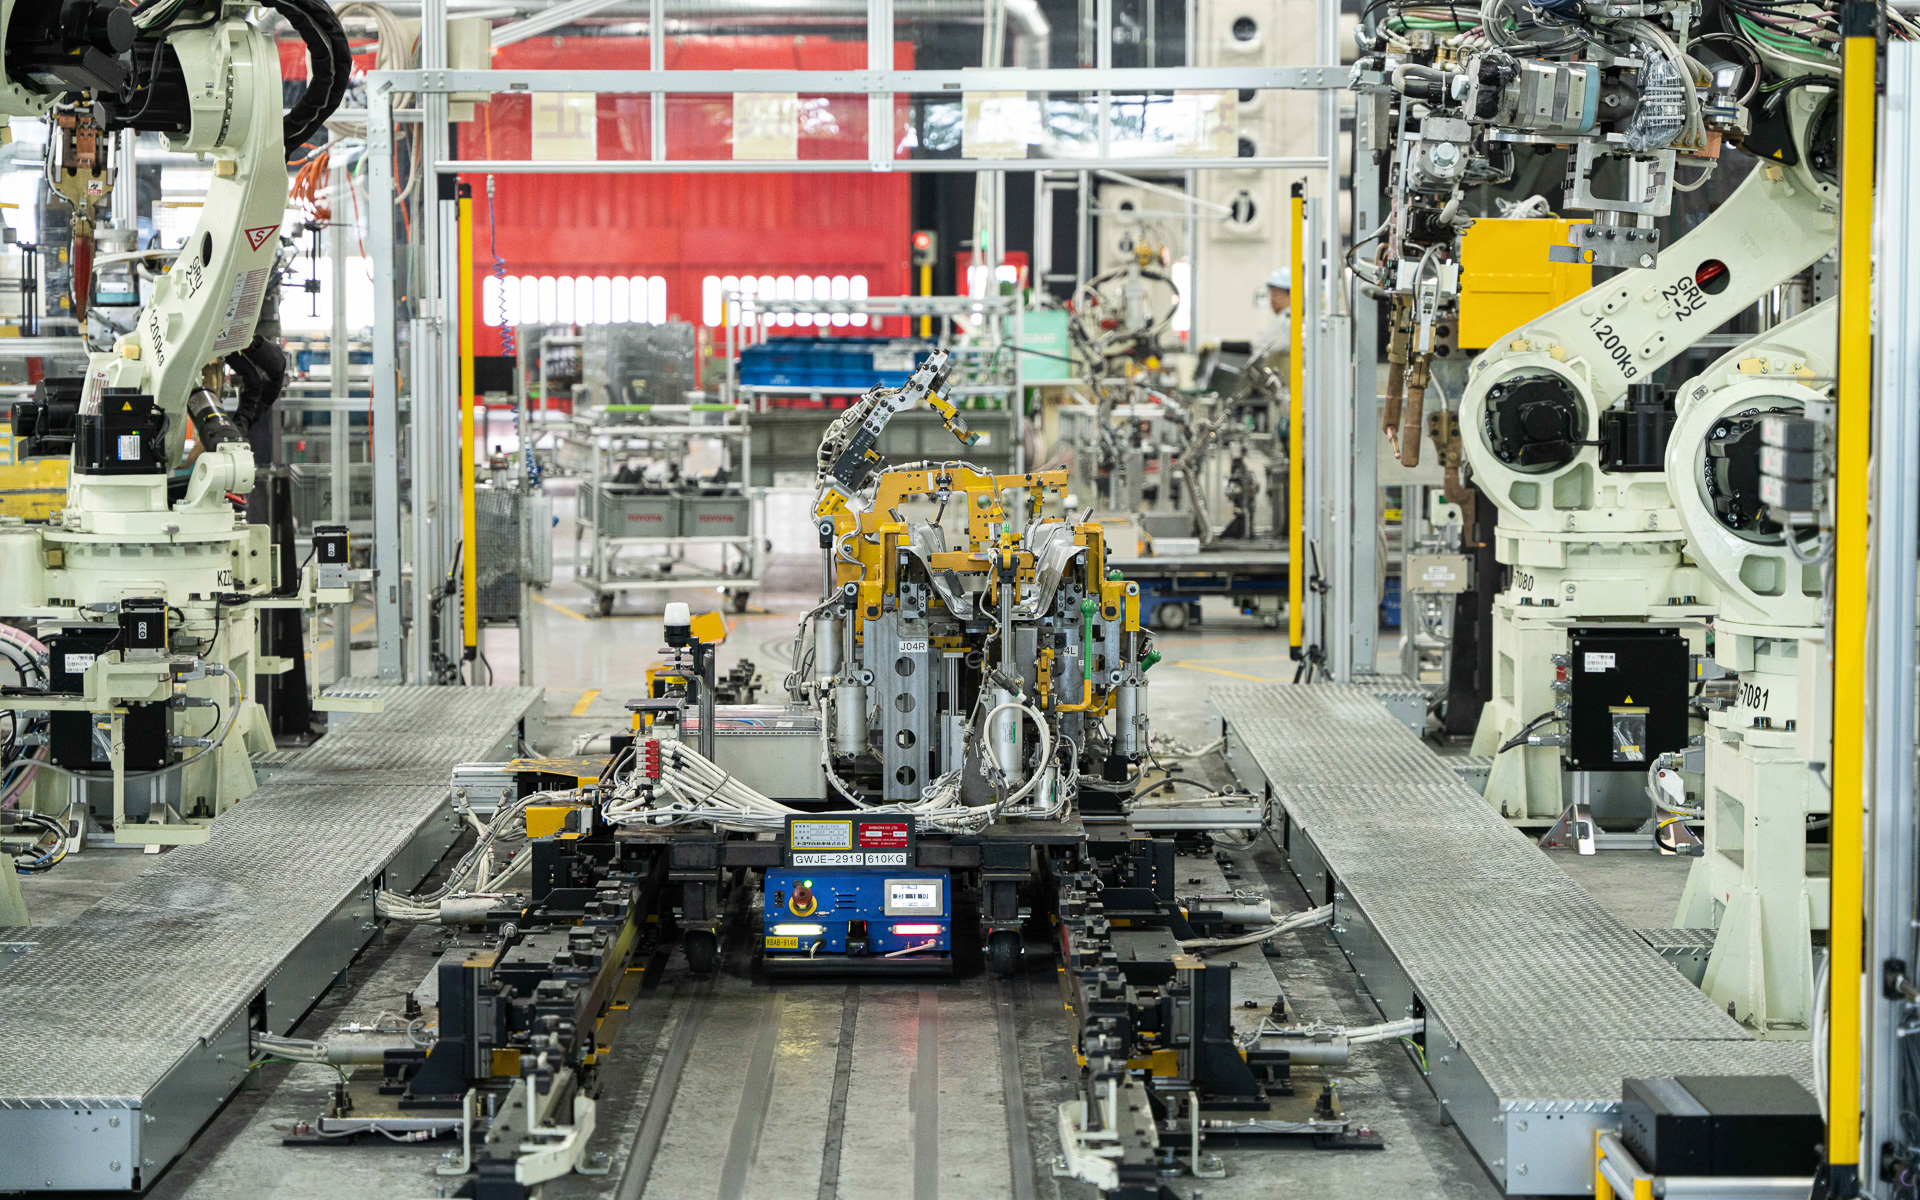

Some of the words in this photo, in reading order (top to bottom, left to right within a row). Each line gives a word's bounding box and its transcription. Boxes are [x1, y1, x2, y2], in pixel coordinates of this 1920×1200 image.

[254, 230, 265, 243] S
[186, 265, 196, 299] 2-1
[193, 256, 203, 289] GRU
[1662, 285, 1692, 322] 2-2
[1677, 276, 1707, 311] GRU
[1590, 316, 1638, 379] 1.200kg
[627, 513, 662, 523] TOYOTA
[699, 514, 733, 523] TOYOTA
[900, 642, 926, 651] J04R
[795, 854, 862, 864] GWJE-2919
[867, 854, 904, 863] 610KG
